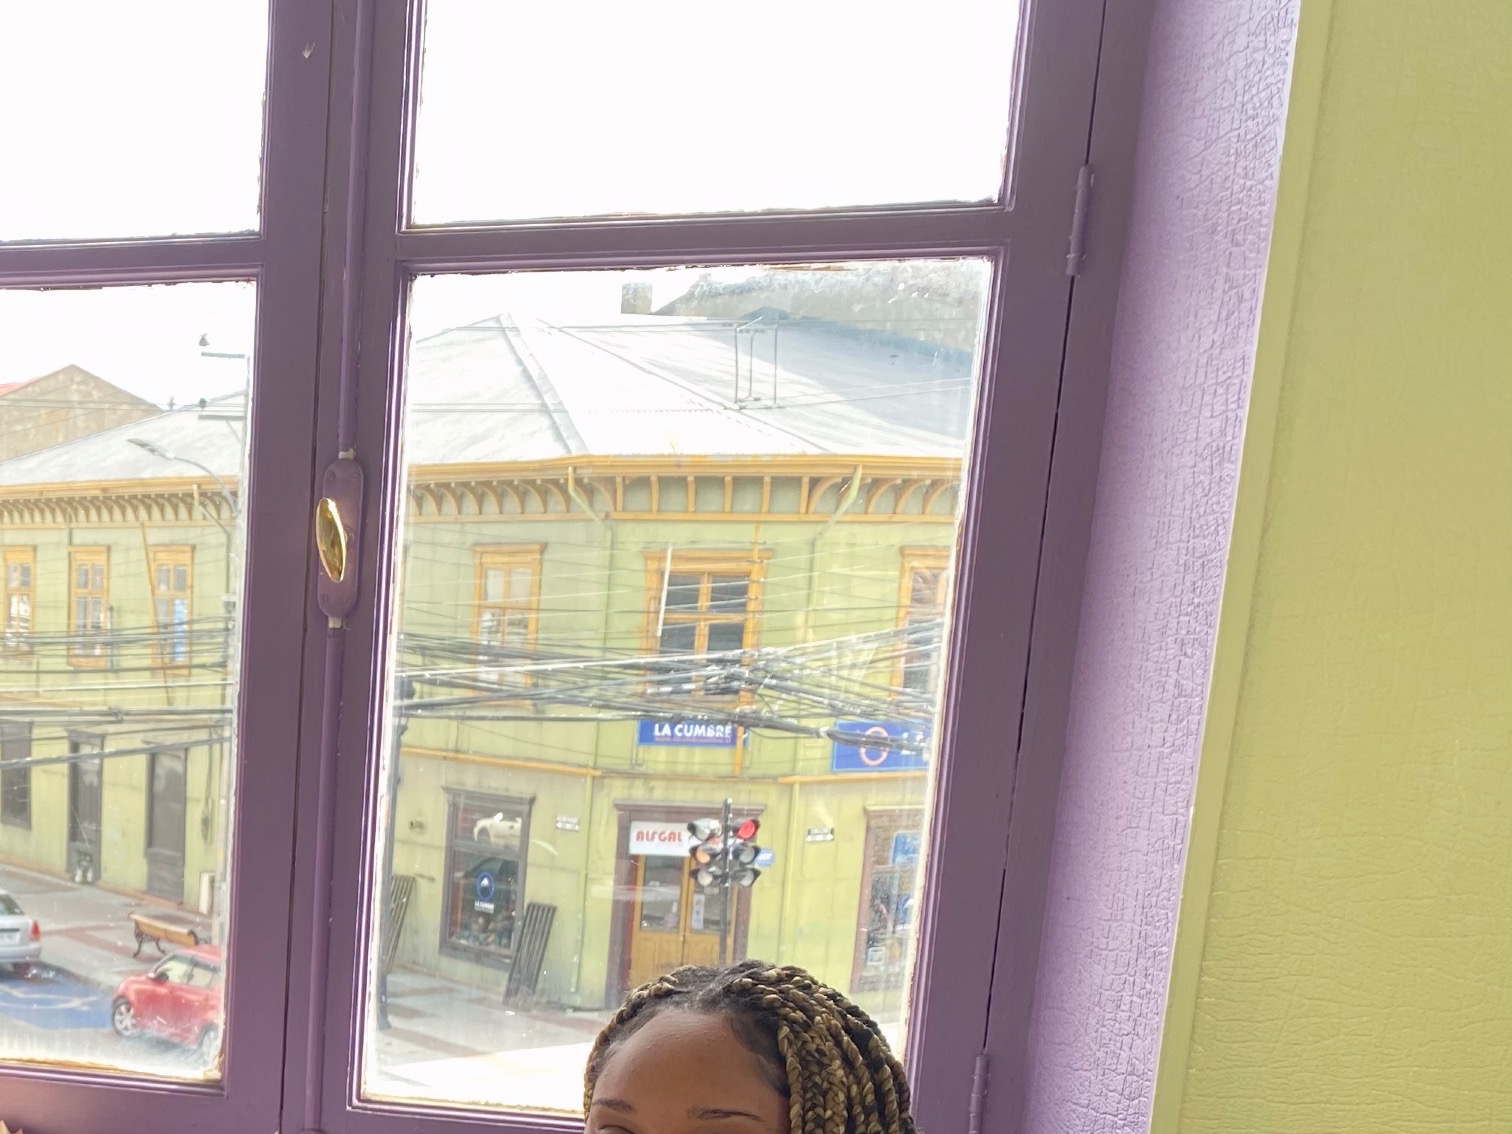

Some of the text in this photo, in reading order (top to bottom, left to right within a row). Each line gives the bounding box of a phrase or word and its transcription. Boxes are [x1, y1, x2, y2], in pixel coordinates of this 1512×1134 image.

[654, 722, 733, 737] LA CUMBRE
[635, 829, 683, 843] ALFGAL
